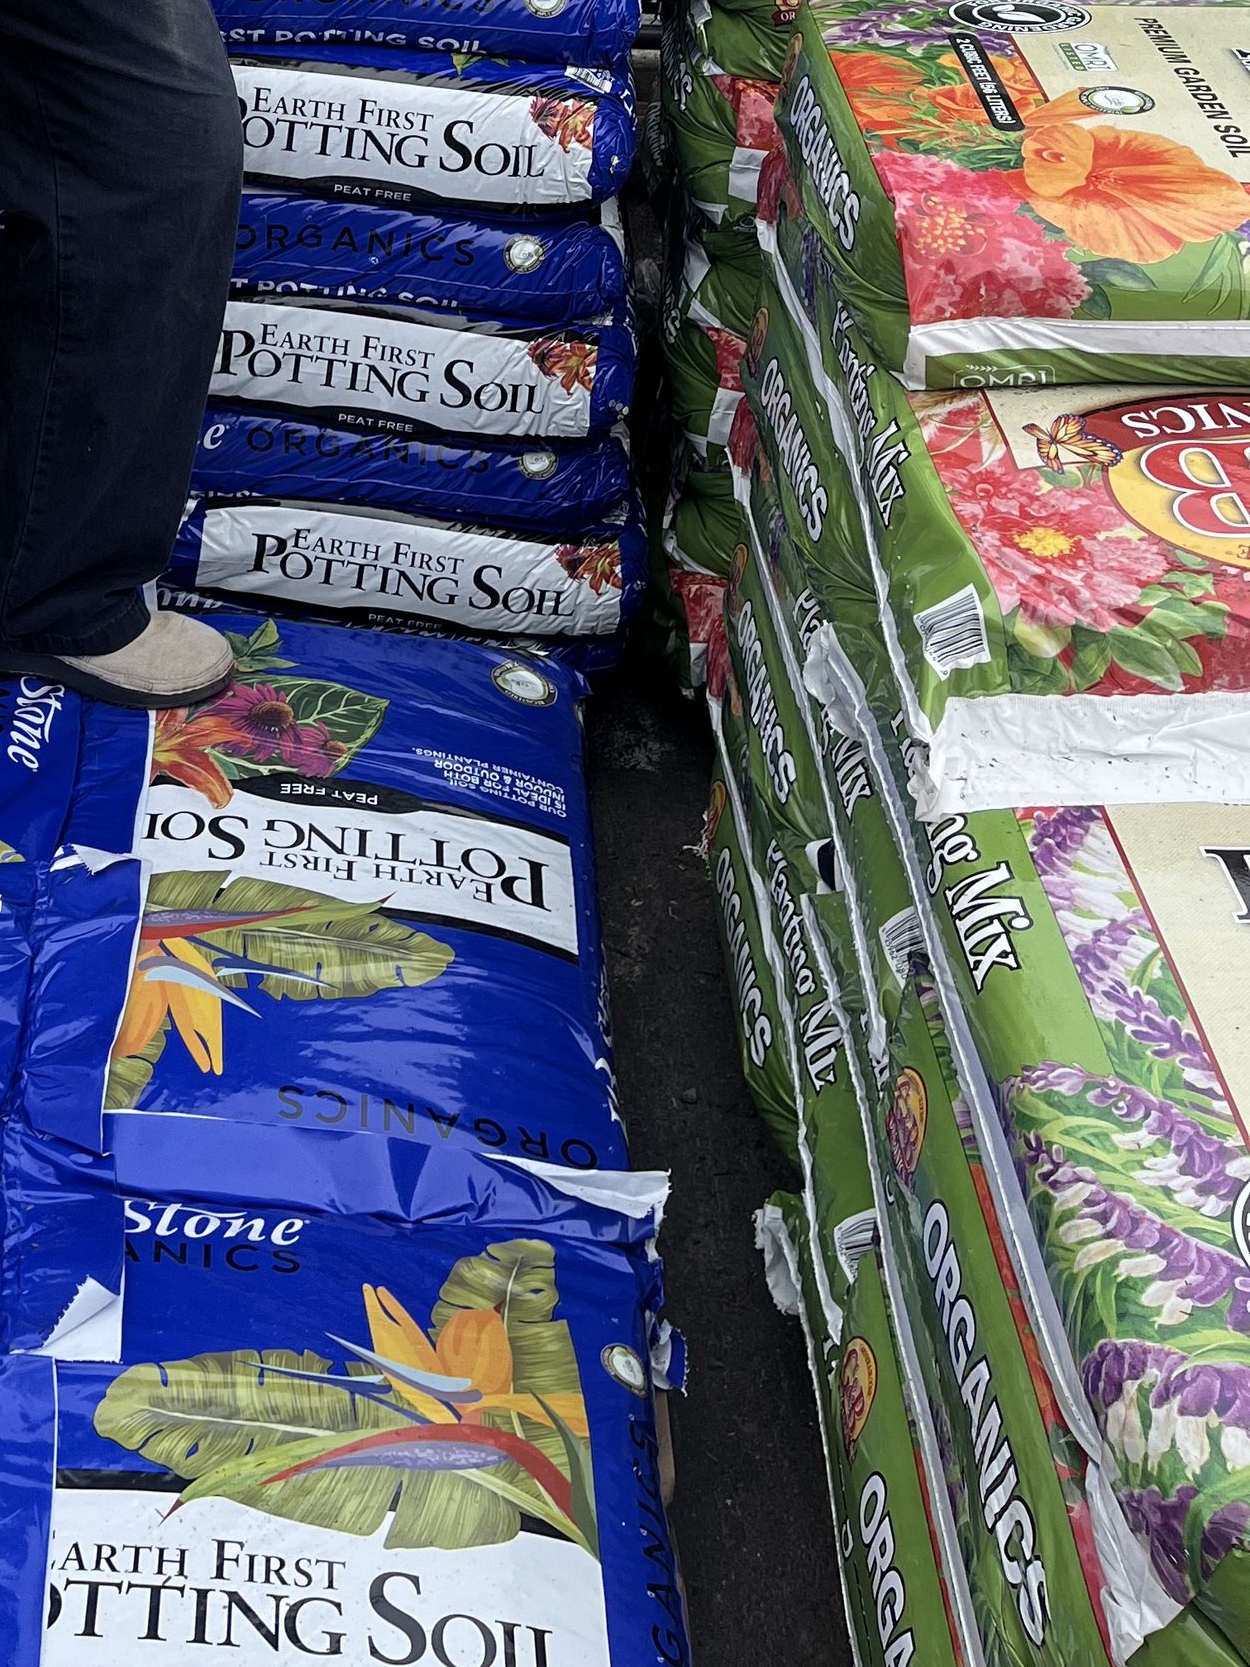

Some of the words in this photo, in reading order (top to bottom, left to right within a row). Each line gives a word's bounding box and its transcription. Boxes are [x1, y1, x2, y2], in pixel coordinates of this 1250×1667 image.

[1073, 43, 1111, 71] OMRI
[251, 86, 347, 122] EARTH
[358, 97, 434, 133] FIRST
[1133, 17, 1193, 64] PREMIUM
[1173, 67, 1235, 121] GARDEN
[1213, 124, 1250, 159] SOIL
[439, 120, 546, 179] SOIL
[790, 74, 861, 252] ORGANICS
[333, 183, 372, 197] PEAT
[374, 187, 412, 202] FREE
[213, 328, 431, 405] POTTING
[438, 359, 546, 416] SOIL
[259, 322, 350, 358] EARTH
[362, 333, 436, 370] FIRST
[337, 412, 375, 426] PEAT
[377, 417, 414, 433] FREE
[759, 357, 829, 542] ORGANICS
[248, 531, 460, 607] POTTING
[468, 564, 575, 619] SOIL
[291, 527, 383, 558] EARTH
[389, 540, 465, 577] FIRST
[367, 613, 401, 626] PEAT
[737, 600, 798, 805] ORGANICS
[279, 782, 326, 798] FREE
[433, 758, 501, 782] OUTDOOR
[332, 788, 380, 807] PEAT
[538, 802, 568, 819] OUR
[259, 854, 355, 883] FIRST
[263, 818, 553, 914] POTTING
[372, 863, 495, 905] EARTH
[944, 860, 1035, 993] Mix
[714, 847, 773, 1069] ORGANICS
[277, 1083, 600, 1169] ORGANICS
[921, 1198, 1050, 1648] ORGANICS
[211, 1537, 347, 1591] FIRST
